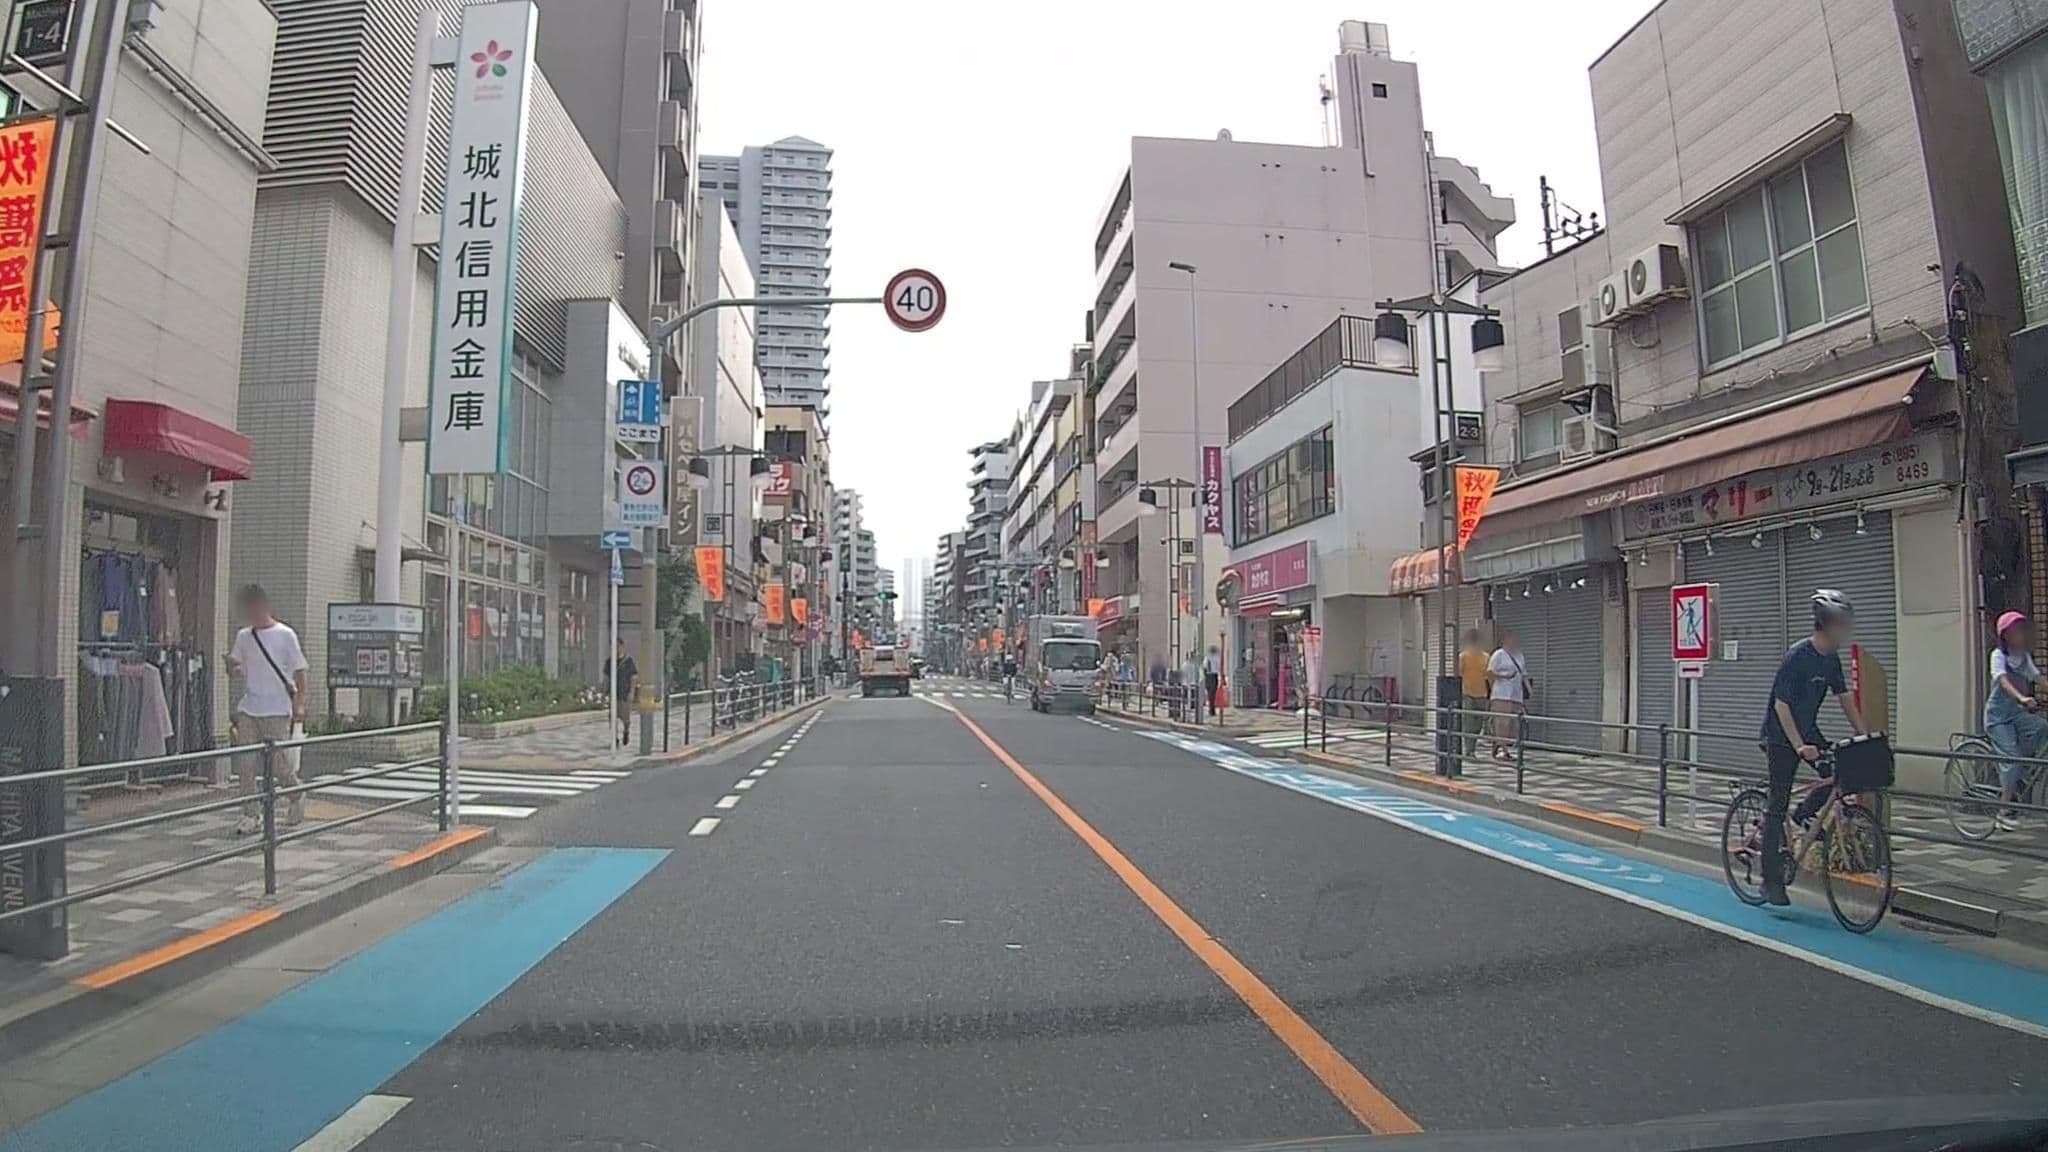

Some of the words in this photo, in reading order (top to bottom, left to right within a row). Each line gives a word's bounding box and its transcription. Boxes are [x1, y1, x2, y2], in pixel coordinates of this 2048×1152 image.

[22, 21, 61, 49] 1-4
[444, 143, 502, 432] 城北信用金庫
[896, 285, 934, 312] 40
[618, 426, 658, 439] ここまで
[1459, 425, 1479, 439] 2-3
[1896, 462, 1929, 482] 8469
[1206, 479, 1220, 528] カクヤス
